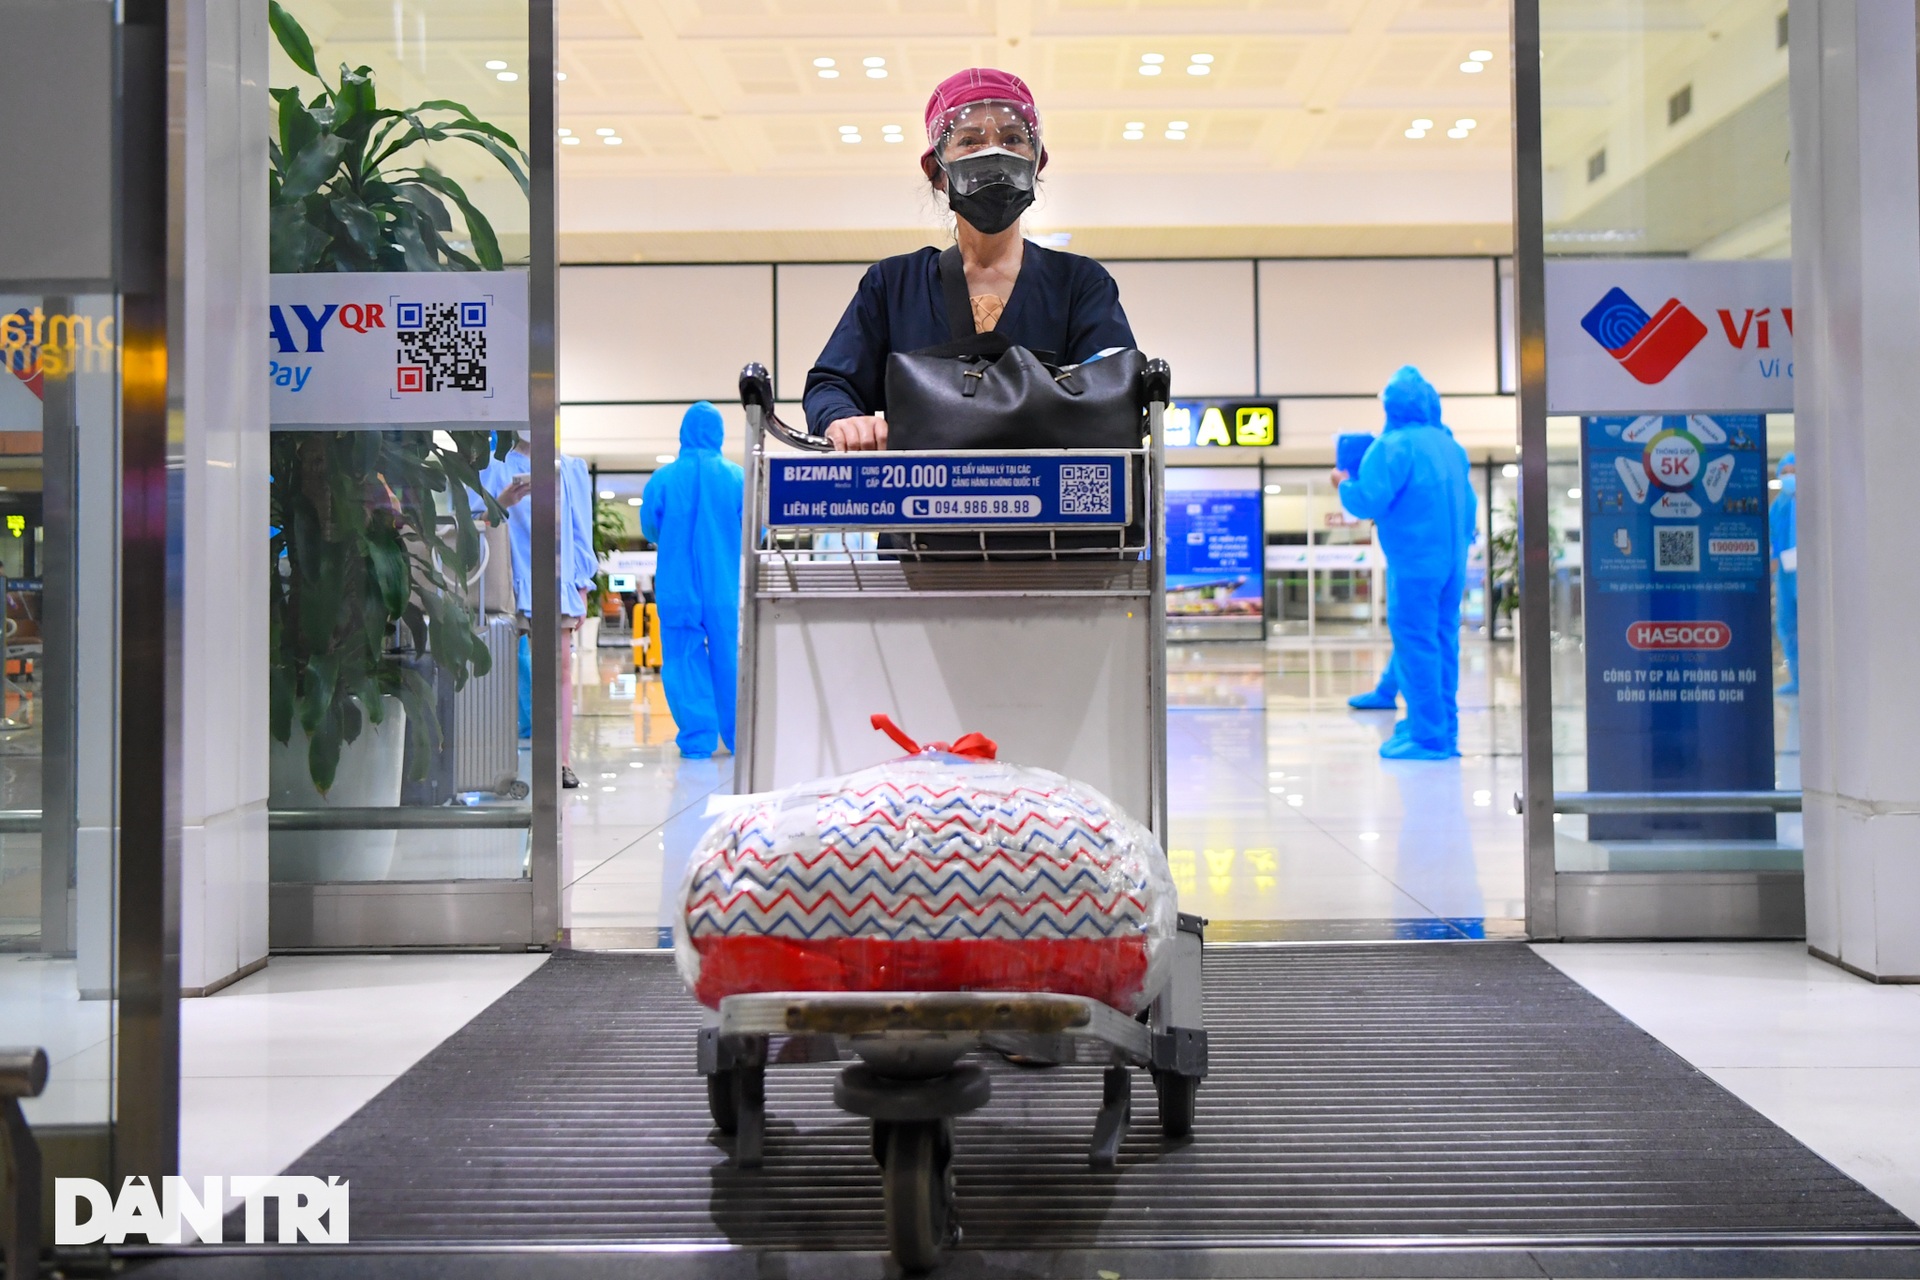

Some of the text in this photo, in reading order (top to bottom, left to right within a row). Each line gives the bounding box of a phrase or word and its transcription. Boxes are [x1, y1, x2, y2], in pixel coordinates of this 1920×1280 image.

[339, 303, 386, 334] QR
[1716, 307, 1771, 350] Ví
[1759, 358, 1779, 378] Ví
[1195, 407, 1231, 446] A
[784, 465, 853, 481] BIZMAN
[881, 464, 948, 488] 20.000
[952, 466, 961, 474] XE
[976, 464, 996, 475] HÀNH
[996, 464, 1005, 475] LÝ
[1005, 465, 1017, 475] TẠI
[1017, 464, 1031, 475] CÁC
[1661, 457, 1690, 476] 5K
[990, 475, 1013, 487] KHÔNG
[1032, 475, 1041, 487] TẾ
[783, 498, 895, 518] LIÊN HỆ QUẢNG CÁO
[935, 500, 1030, 514] 094.986.98.98
[1637, 627, 1720, 644] HASOCO
[1603, 666, 1757, 684] CÔNG TY CP XÀ PHÒNG HÀ NỘI
[1616, 685, 1745, 704] ĐỒNG HÀNH CHỐNG DỊCH
